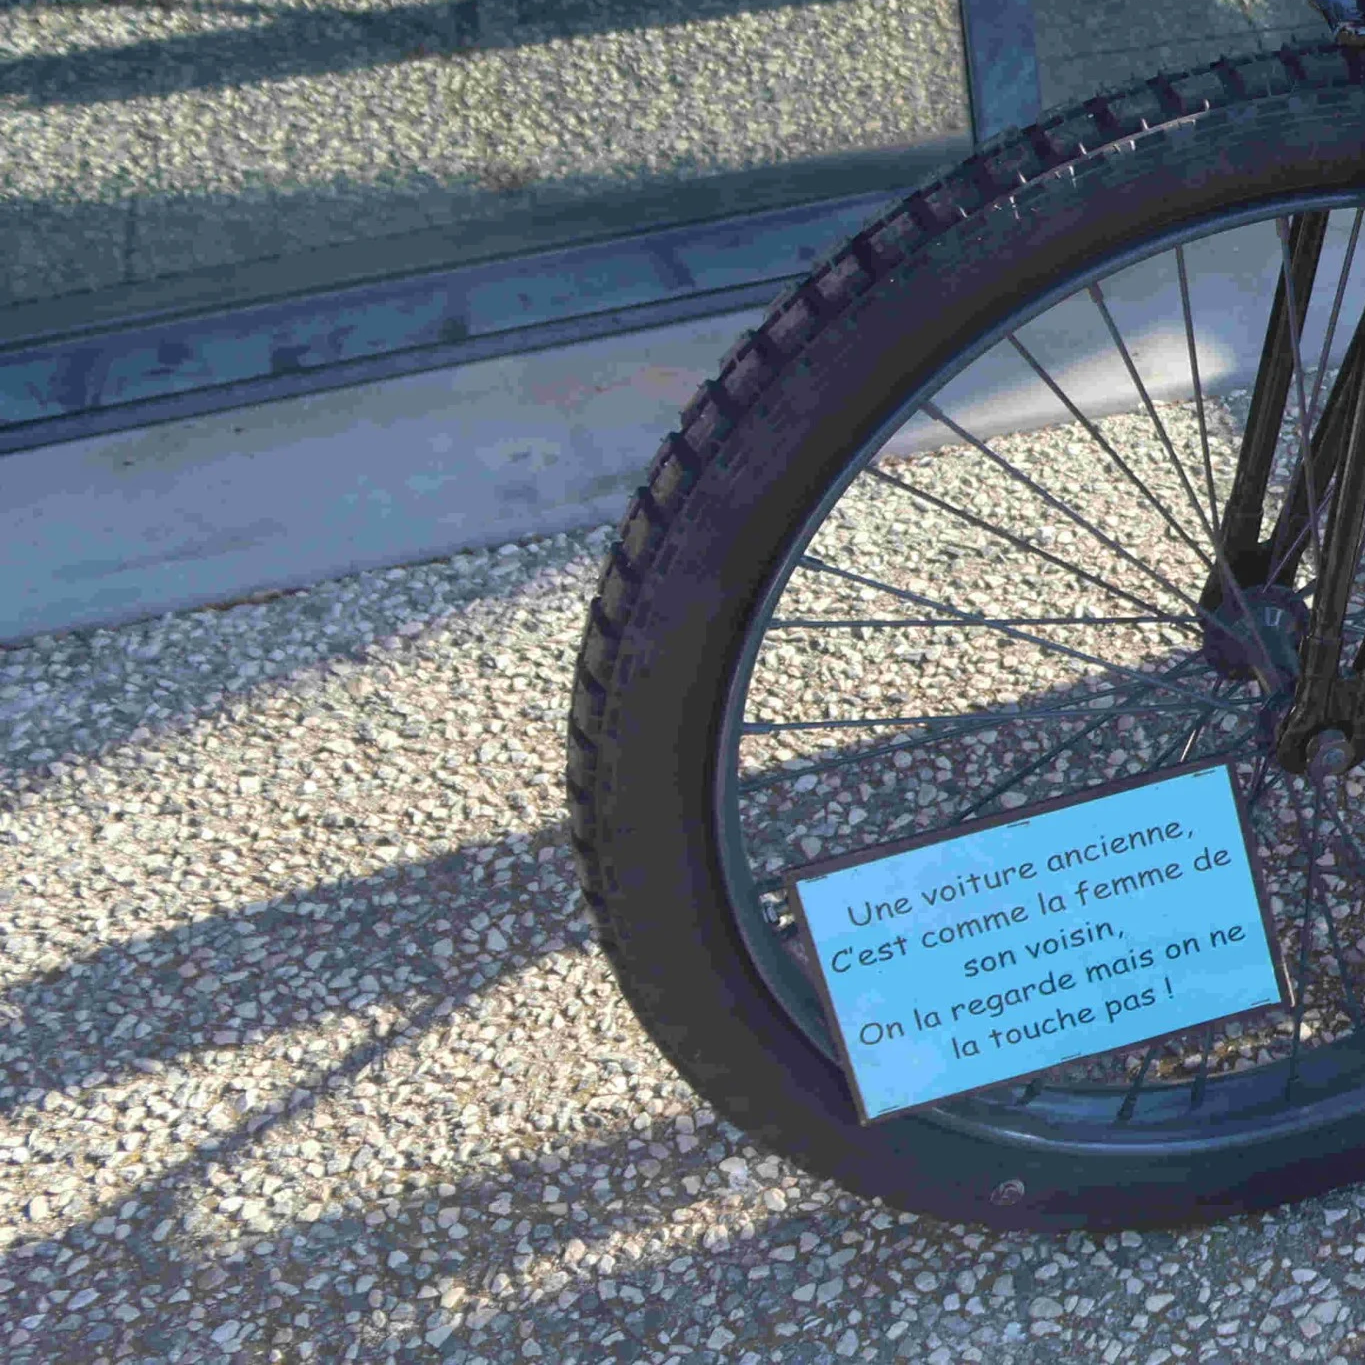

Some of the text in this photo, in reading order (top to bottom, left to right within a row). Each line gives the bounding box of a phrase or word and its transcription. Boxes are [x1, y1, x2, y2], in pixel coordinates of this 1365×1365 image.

[830, 844, 1232, 975] C'est comme la femme de
[847, 818, 1195, 928] Une voiture ancienne,
[858, 921, 1247, 1047] On la regarde mais on ne
[963, 917, 1126, 979] son voisin,
[952, 1036, 980, 1061] la
[988, 1002, 1096, 1052] touche
[1104, 989, 1156, 1025] pas
